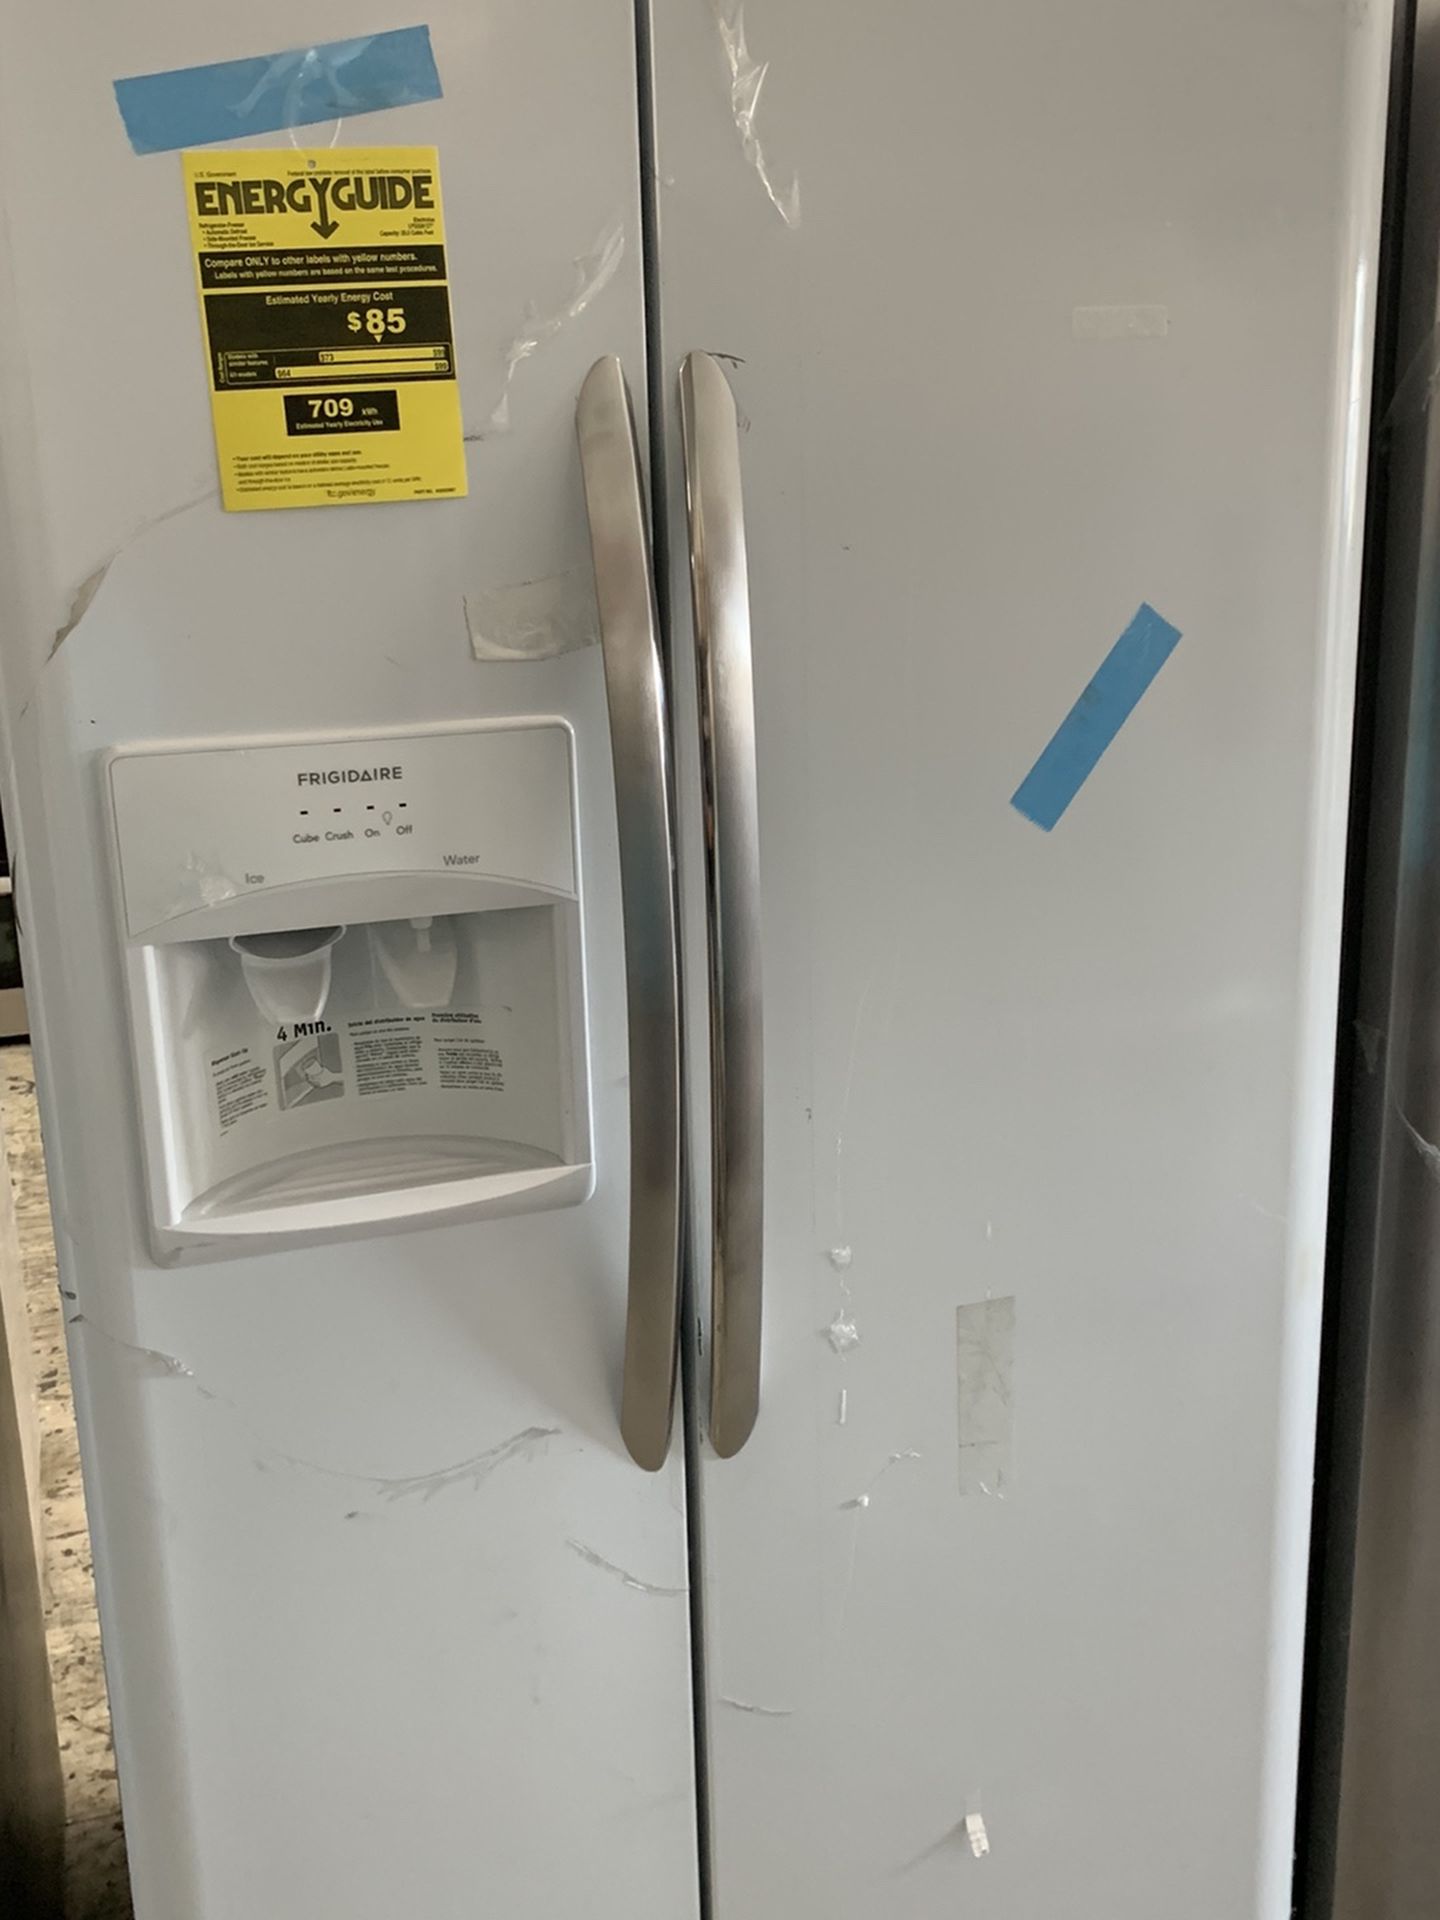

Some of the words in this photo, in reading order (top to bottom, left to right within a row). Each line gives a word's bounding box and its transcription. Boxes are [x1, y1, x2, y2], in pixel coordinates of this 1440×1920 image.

[194, 176, 435, 216] ENERGYGUIDE
[204, 258, 243, 268] Compare
[245, 256, 270, 266] ONLY
[271, 256, 280, 266] to
[282, 256, 304, 265] other
[306, 254, 331, 264] labels
[332, 254, 351, 264] with
[352, 253, 378, 264] yellow
[380, 252, 418, 262] numbers.
[214, 272, 238, 280] Labels
[256, 270, 278, 280] yellow
[278, 270, 308, 278] numbers
[322, 268, 344, 276] based
[354, 266, 366, 274] the
[366, 266, 384, 274] same
[265, 294, 310, 306] Estimated
[311, 294, 338, 305] Yearly
[340, 292, 372, 304] Energy
[372, 291, 394, 301] Cost
[346, 307, 406, 334] $85
[320, 352, 334, 362] $73
[276, 368, 292, 377] $64
[308, 397, 354, 418] 709
[296, 422, 325, 430] Estimated
[326, 420, 344, 428] Yearly
[344, 420, 372, 428] Electricity
[297, 766, 402, 786] FRIGIDAIRE
[293, 832, 320, 844] Cube
[325, 830, 354, 842] Crush
[364, 828, 380, 838] On
[396, 824, 413, 836] Off
[443, 854, 480, 866] Water
[244, 872, 264, 884] Ice
[276, 1026, 288, 1042] 4
[294, 1020, 332, 1038] Min.
